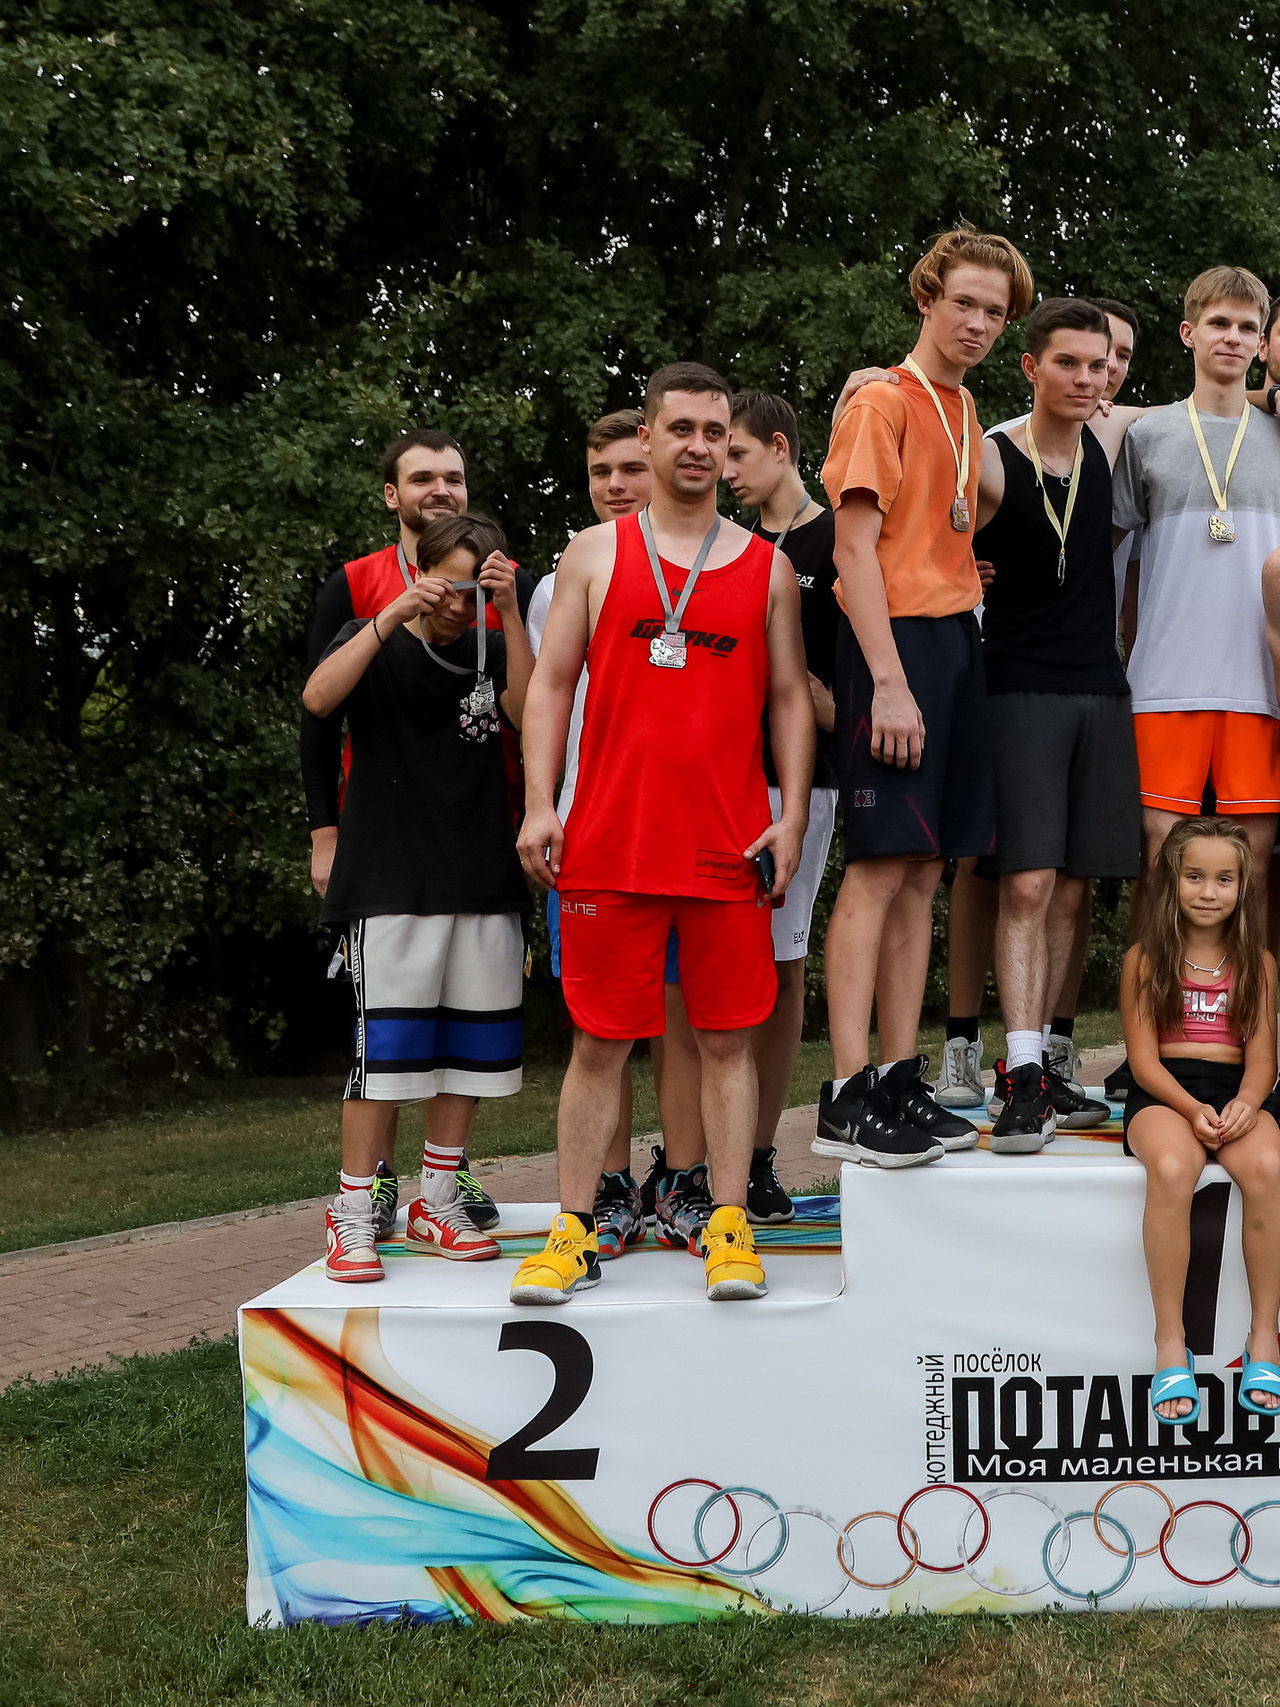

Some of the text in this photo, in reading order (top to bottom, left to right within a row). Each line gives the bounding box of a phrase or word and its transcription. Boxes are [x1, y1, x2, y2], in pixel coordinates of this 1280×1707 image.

[561, 899, 597, 916] ELITE
[1182, 991, 1228, 1013] FILA
[1182, 1182, 1232, 1355] 1
[953, 1347, 1043, 1373] посёлок
[485, 1320, 601, 1480] 2
[917, 1354, 950, 1484] коттеджный
[968, 1453, 1047, 1477] Моя
[1060, 1452, 1263, 1477] маленькая
